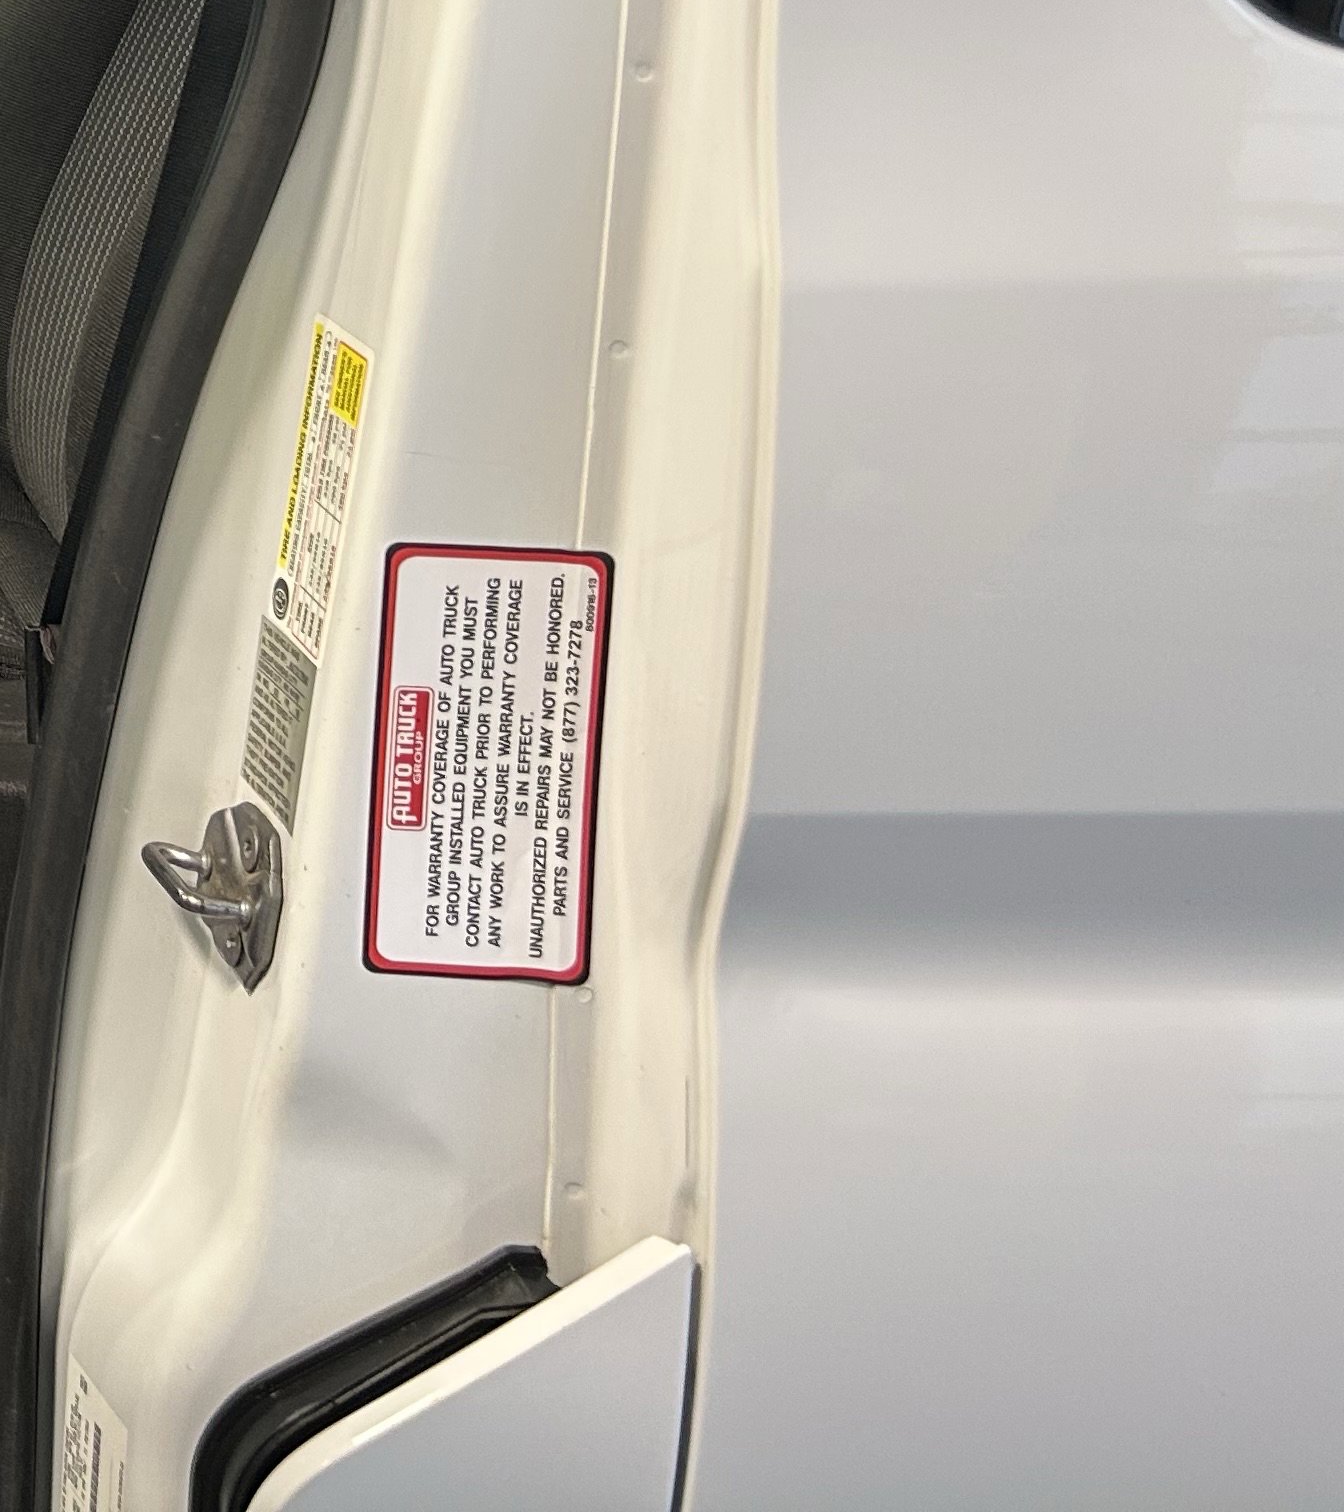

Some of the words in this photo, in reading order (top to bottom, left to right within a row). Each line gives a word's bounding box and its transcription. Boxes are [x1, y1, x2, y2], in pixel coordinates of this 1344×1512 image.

[301, 334, 322, 429] INFORMATION
[290, 432, 306, 494] LOADING
[286, 497, 296, 528] AND
[281, 529, 290, 560] TIRE
[443, 585, 458, 637] TRUCK
[463, 597, 477, 640] MUST
[481, 577, 500, 679] PERFORMING
[504, 579, 522, 664] COVERAGE
[546, 573, 564, 654] HONORED.
[440, 644, 454, 686] AUTO
[460, 647, 474, 678] YOU
[544, 661, 558, 682] BE
[566, 620, 582, 695] 323-7278
[438, 691, 450, 712] OF
[479, 686, 492, 706] TO
[498, 670, 515, 756] WARRANTY
[542, 687, 556, 720] NOT
[562, 701, 580, 742] (877)
[396, 692, 418, 757] TRUCK
[454, 685, 471, 774] EQUIPMENT
[476, 713, 490, 759] PRIOR
[518, 711, 533, 774] EFFECT.
[539, 725, 553, 758] MAY
[413, 731, 424, 784] GROUP
[432, 719, 449, 804] COVERAGE
[392, 762, 418, 824] AUTO
[472, 766, 487, 819] TRUCK
[494, 763, 509, 827] ASSURE
[515, 801, 528, 816] IS
[516, 780, 529, 796] IN
[535, 764, 550, 830] REPAIRS
[557, 751, 573, 819] SERVICE
[450, 781, 465, 864] INSTALLED
[470, 825, 484, 868] AUTO
[492, 833, 505, 854] TO
[556, 826, 568, 860] AND
[428, 810, 443, 896] WARRANTY
[446, 870, 460, 926] GROUP
[466, 873, 481, 947] CONTACT
[490, 861, 504, 908] WORK
[530, 837, 546, 958] UNAUTHORIZED
[553, 866, 567, 916] PARTS
[426, 904, 439, 936] FOR
[488, 915, 501, 947] ANY
